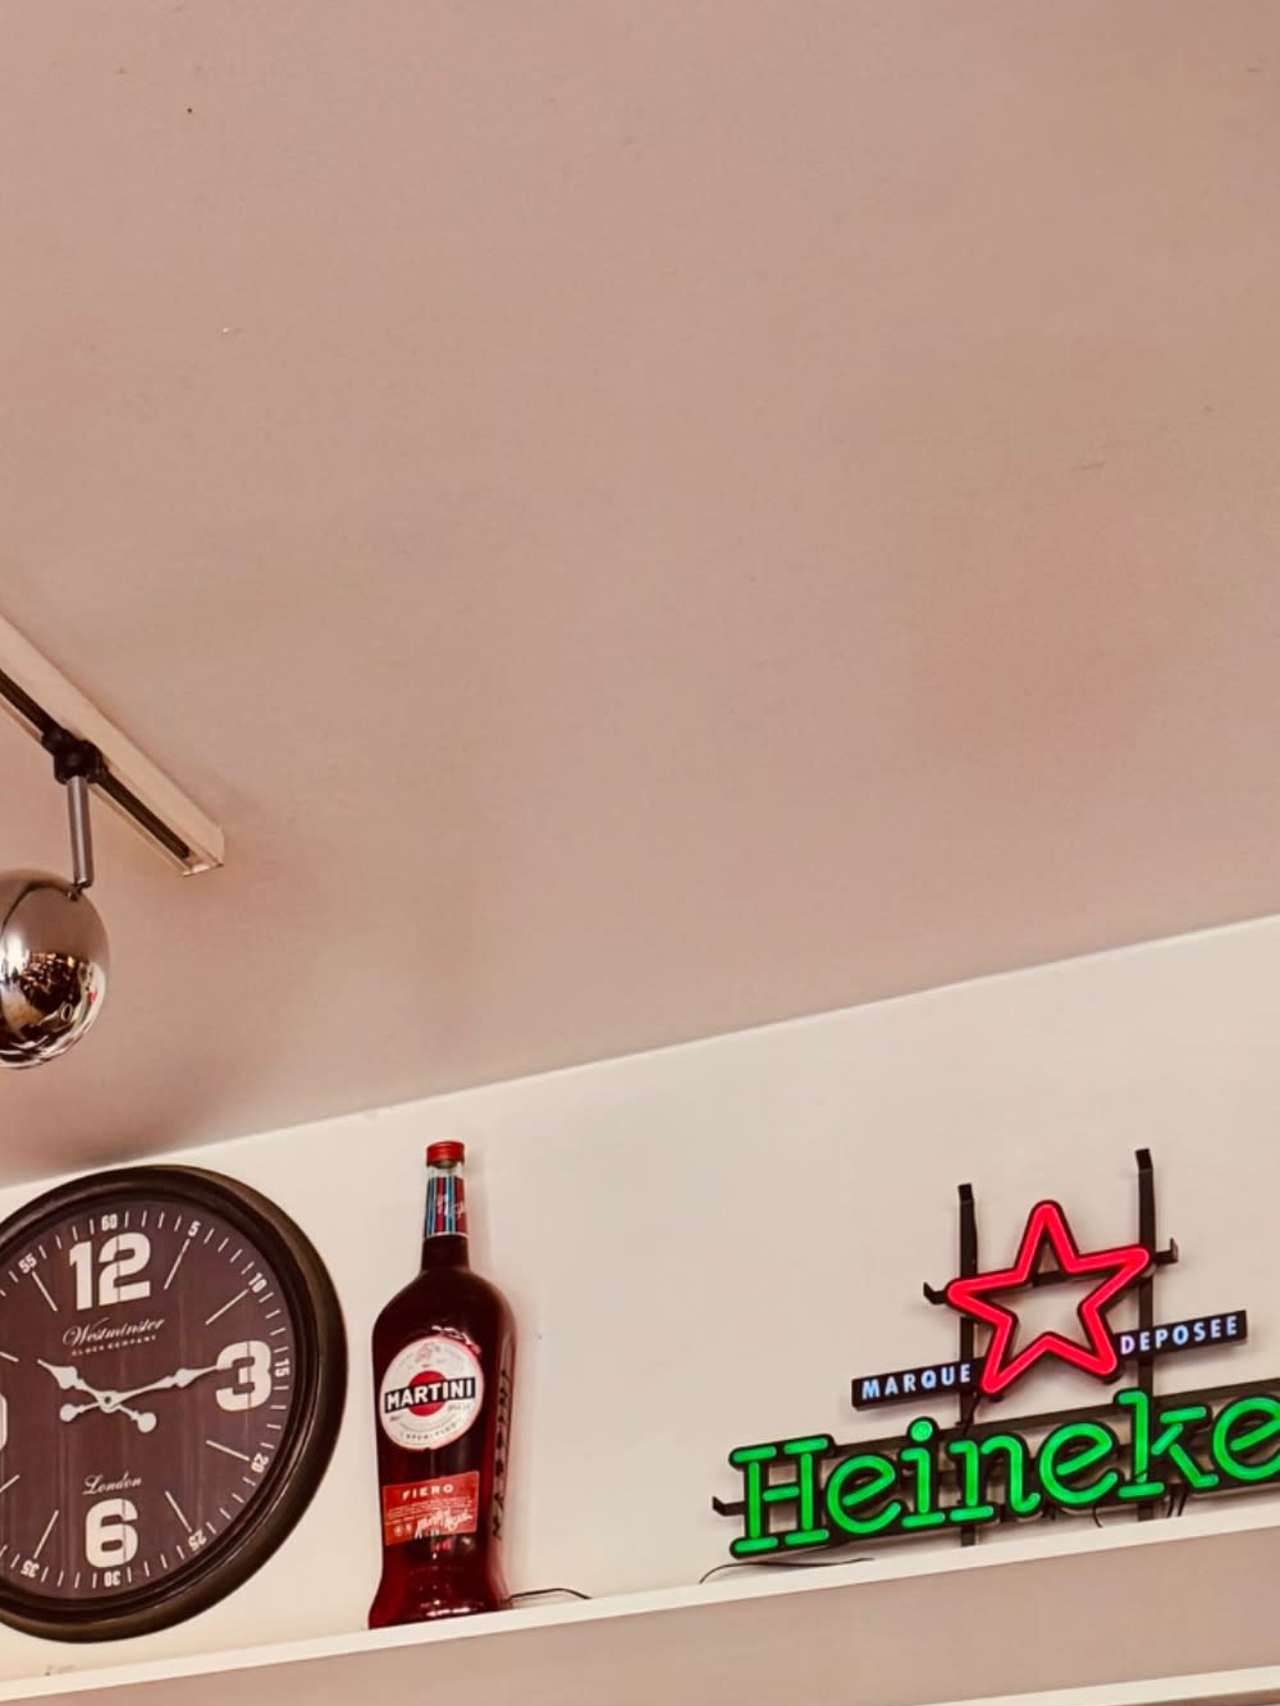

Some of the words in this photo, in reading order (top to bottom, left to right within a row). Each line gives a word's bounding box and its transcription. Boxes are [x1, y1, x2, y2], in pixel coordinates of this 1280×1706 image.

[101, 1214, 118, 1229] 60
[189, 1222, 200, 1237] 5
[18, 1253, 37, 1273] 55
[69, 1232, 151, 1310] 12
[248, 1272, 268, 1294] 10
[861, 1364, 971, 1400] MARQUE
[1120, 1315, 1238, 1355] DEPOSEE
[215, 1340, 272, 1411] 3
[276, 1359, 289, 1378] 15
[387, 1380, 472, 1410] MARTINI
[251, 1455, 268, 1473] 20
[82, 1472, 142, 1495] London
[402, 1484, 454, 1500] FIERO
[85, 1498, 138, 1568] 6
[189, 1531, 206, 1552] 25
[22, 1561, 40, 1578] 35
[104, 1570, 120, 1586] 30
